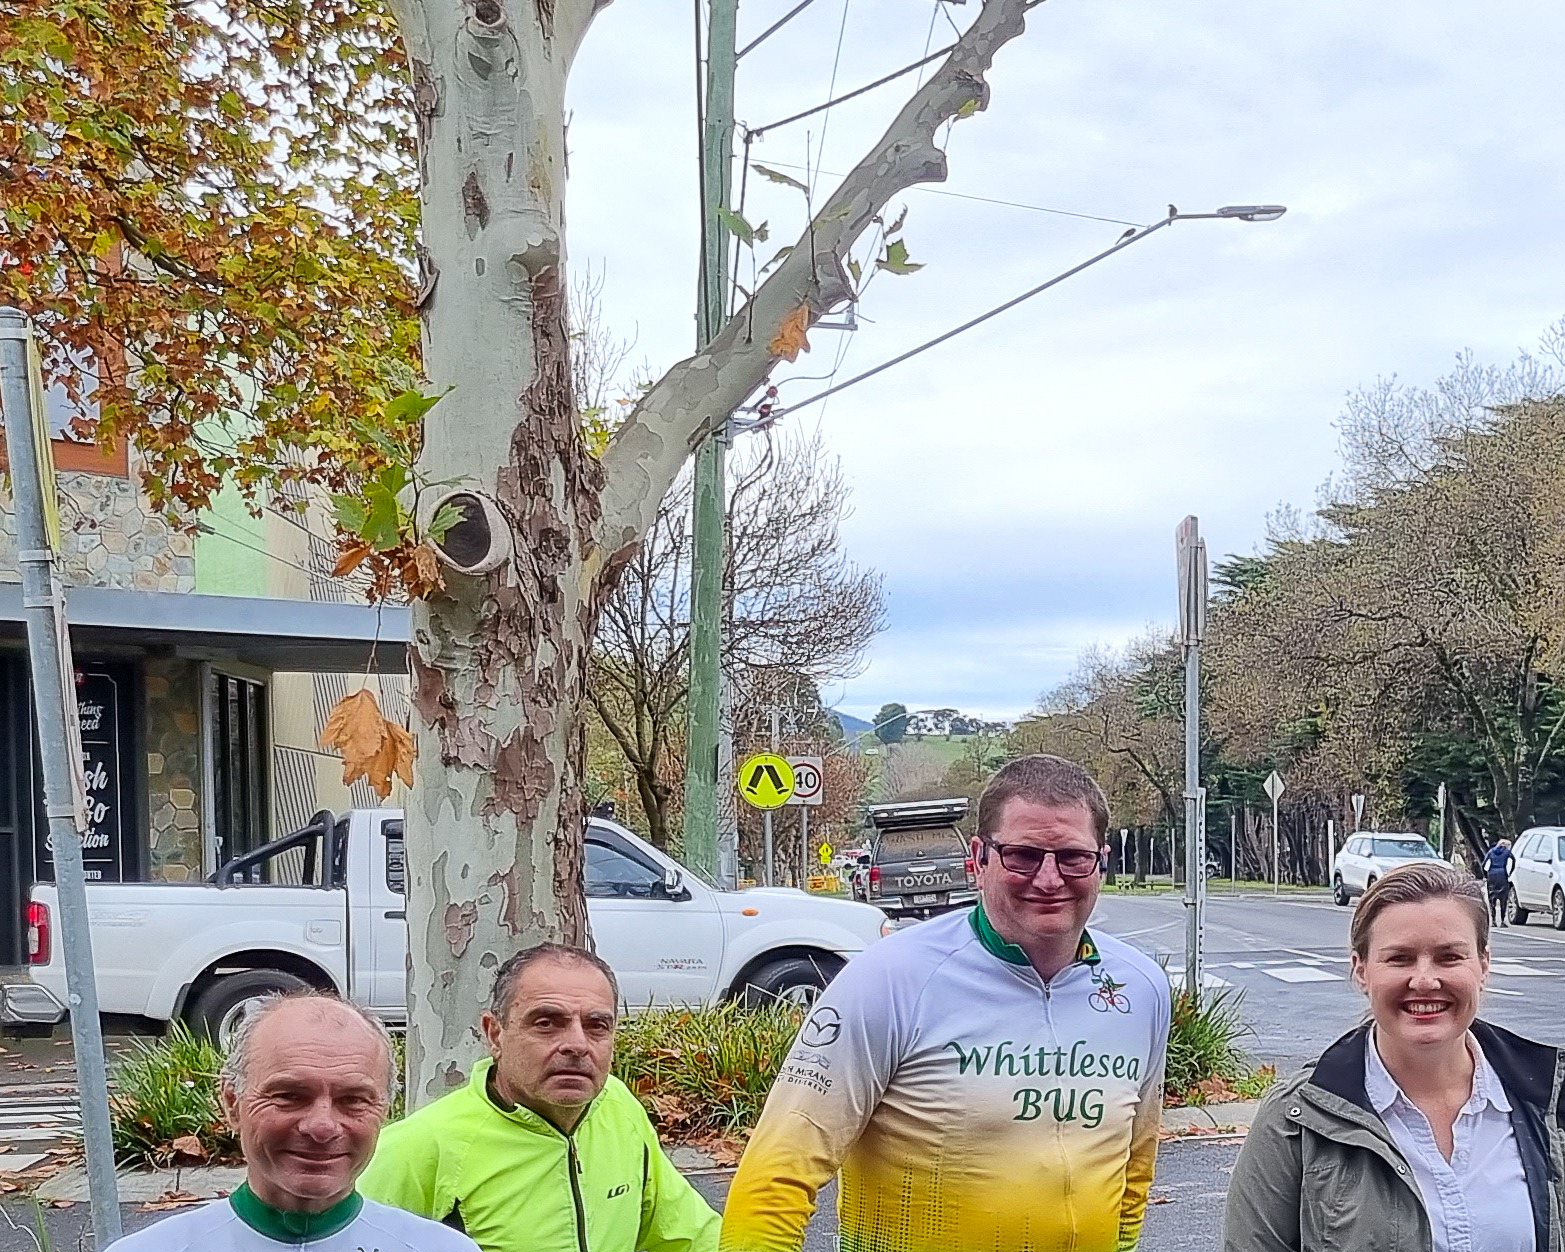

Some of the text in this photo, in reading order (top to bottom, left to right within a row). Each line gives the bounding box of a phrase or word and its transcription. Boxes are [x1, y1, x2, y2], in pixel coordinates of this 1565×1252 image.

[796, 772, 817, 788] 40
[894, 872, 953, 888] TOYOTA
[943, 1041, 1141, 1082] Whittlesea
[1012, 1088, 1104, 1129] BUG
